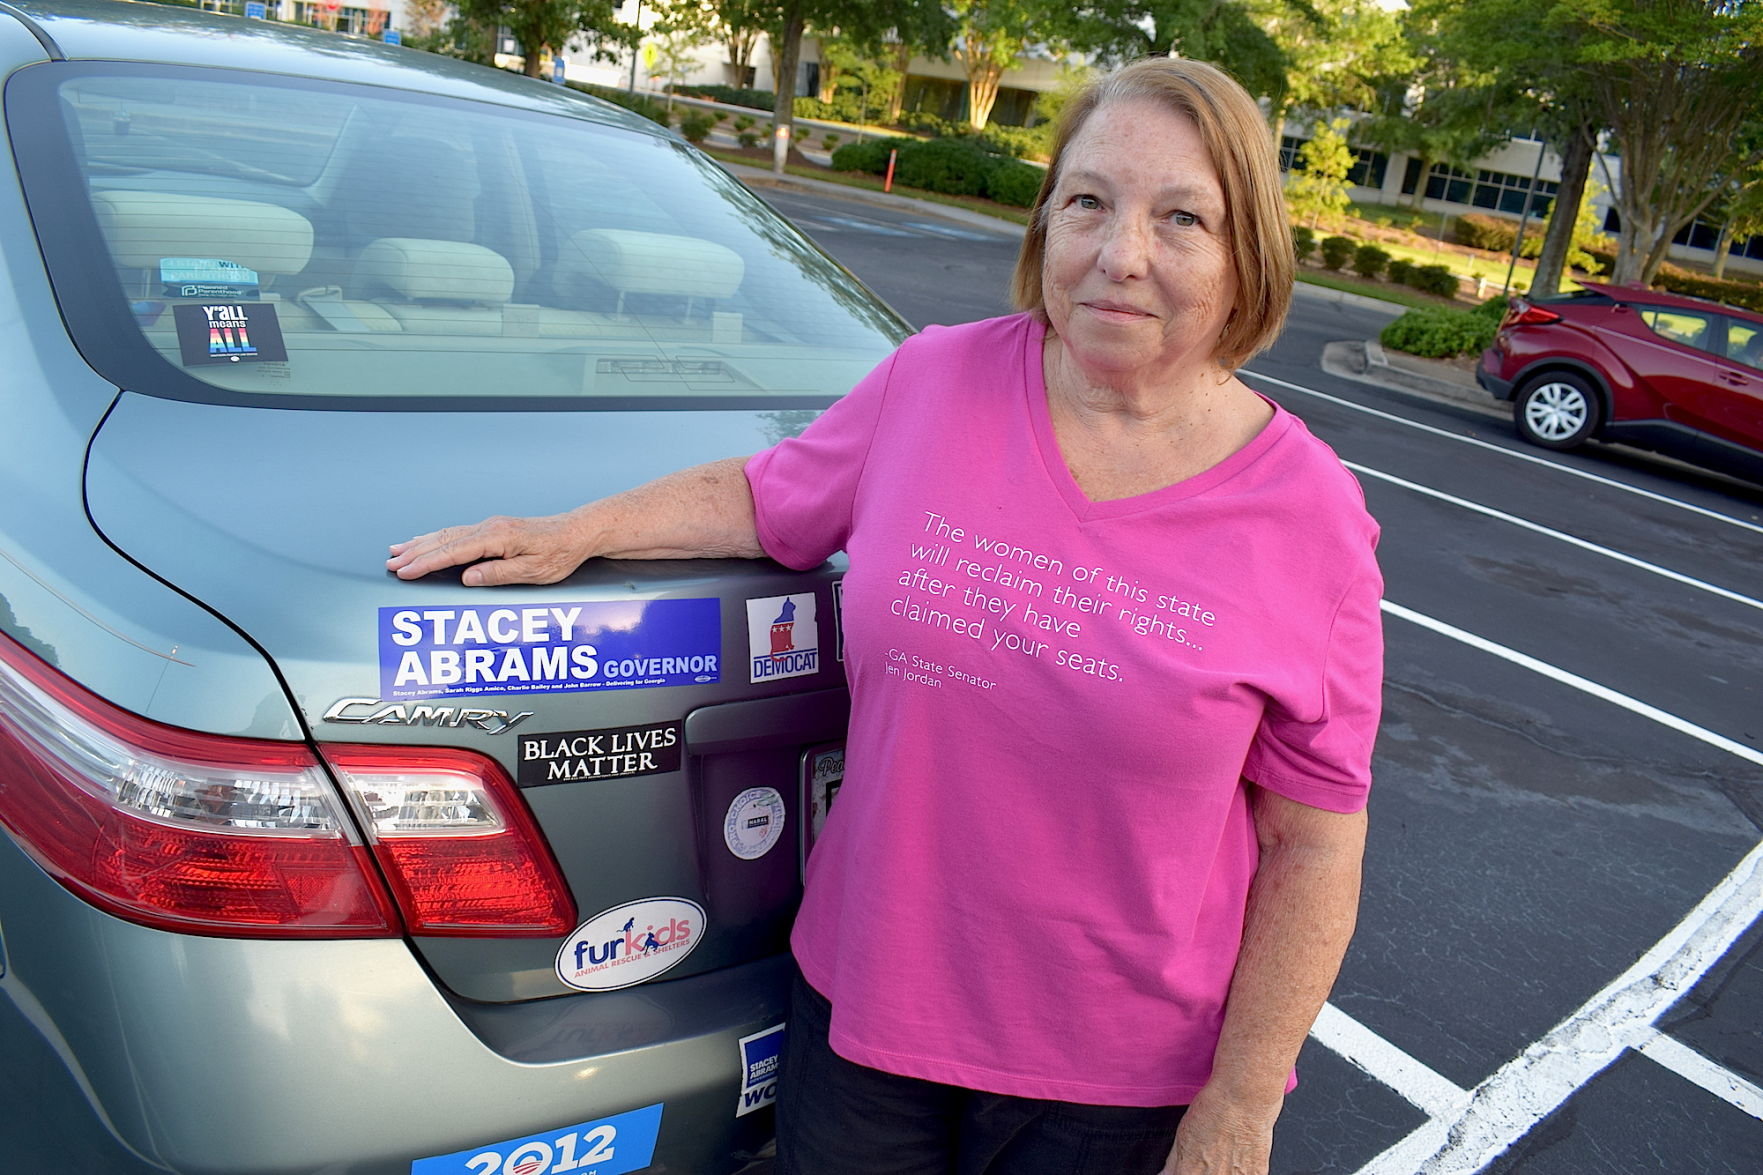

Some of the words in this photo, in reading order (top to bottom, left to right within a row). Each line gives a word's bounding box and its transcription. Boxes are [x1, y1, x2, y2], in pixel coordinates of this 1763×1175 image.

[209, 320, 246, 328] means
[210, 327, 257, 353] ALL
[925, 511, 965, 542] The
[974, 534, 1063, 576] women
[1072, 565, 1103, 583] of
[1106, 575, 1148, 602] this
[1157, 594, 1216, 627] state
[898, 568, 956, 598] after
[963, 586, 1017, 622] they
[1023, 603, 1081, 638] have
[911, 543, 950, 567] will
[955, 557, 1043, 598] reclaim
[1053, 586, 1112, 616] their
[1118, 607, 1204, 651] rights...
[391, 607, 582, 646] STACEY
[890, 595, 985, 640] claimed
[991, 628, 1050, 658] your
[1055, 649, 1124, 683] seats.
[393, 645, 599, 687] ABRAMS
[603, 655, 718, 678] GOVERNOR
[753, 651, 818, 678] DEMOCAT
[885, 661, 900, 677] Jen
[903, 667, 942, 689] Jordan
[911, 655, 943, 674] State
[947, 665, 997, 691] Senator
[323, 696, 535, 735] CAMRY
[524, 735, 604, 760] BLACK
[611, 727, 676, 753] LIVES
[547, 752, 658, 780] MATTER
[817, 756, 844, 777] Pea
[574, 917, 692, 970] furkids
[574, 962, 609, 979] ANIMAL
[611, 953, 641, 968] RESCUE
[653, 939, 691, 957] SHELTERS
[750, 1054, 778, 1072] STACEY
[750, 1062, 780, 1079] ABRAM
[744, 1082, 777, 1108] WO
[464, 1124, 617, 1175] 2012
